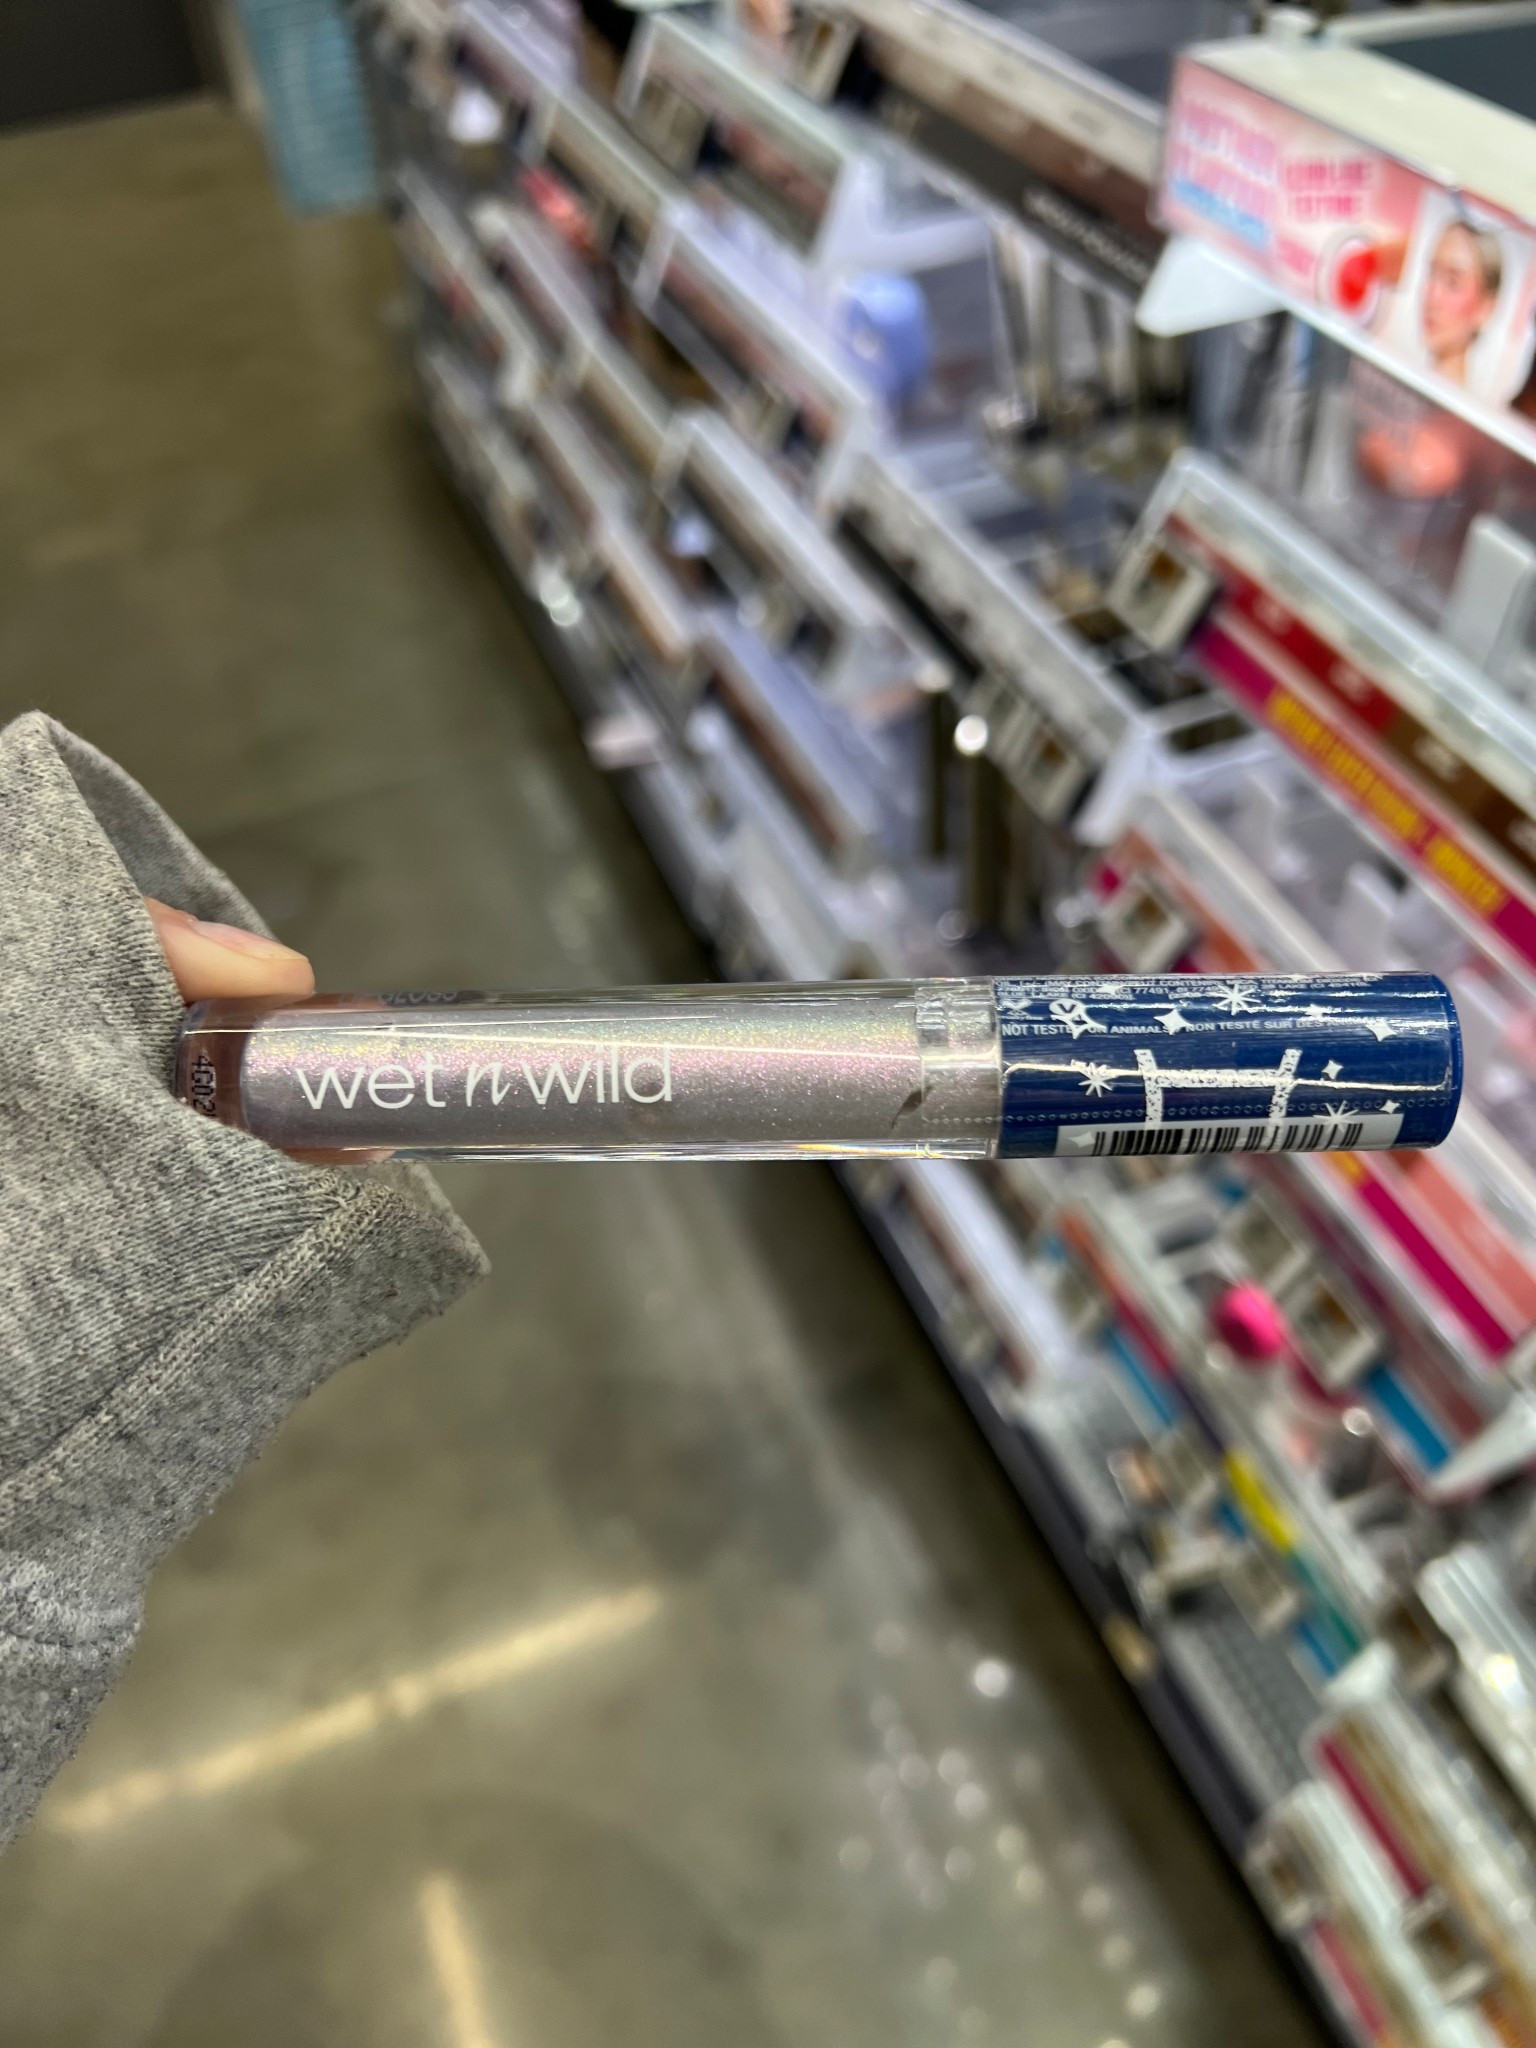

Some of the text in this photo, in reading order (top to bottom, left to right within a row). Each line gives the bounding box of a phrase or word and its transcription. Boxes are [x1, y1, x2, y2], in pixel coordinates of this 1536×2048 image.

[1002, 1024, 1029, 1036] NOT
[1031, 1024, 1083, 1035] TESTE
[1110, 1025, 1169, 1034] ANIMALS
[1186, 1022, 1215, 1032] NON
[1218, 1019, 1261, 1030] TESTÉ
[1264, 1018, 1293, 1029] SUR
[1296, 1018, 1322, 1028] DES
[191, 1055, 217, 1118] 4G02
[296, 1043, 673, 1111] wet n wild
